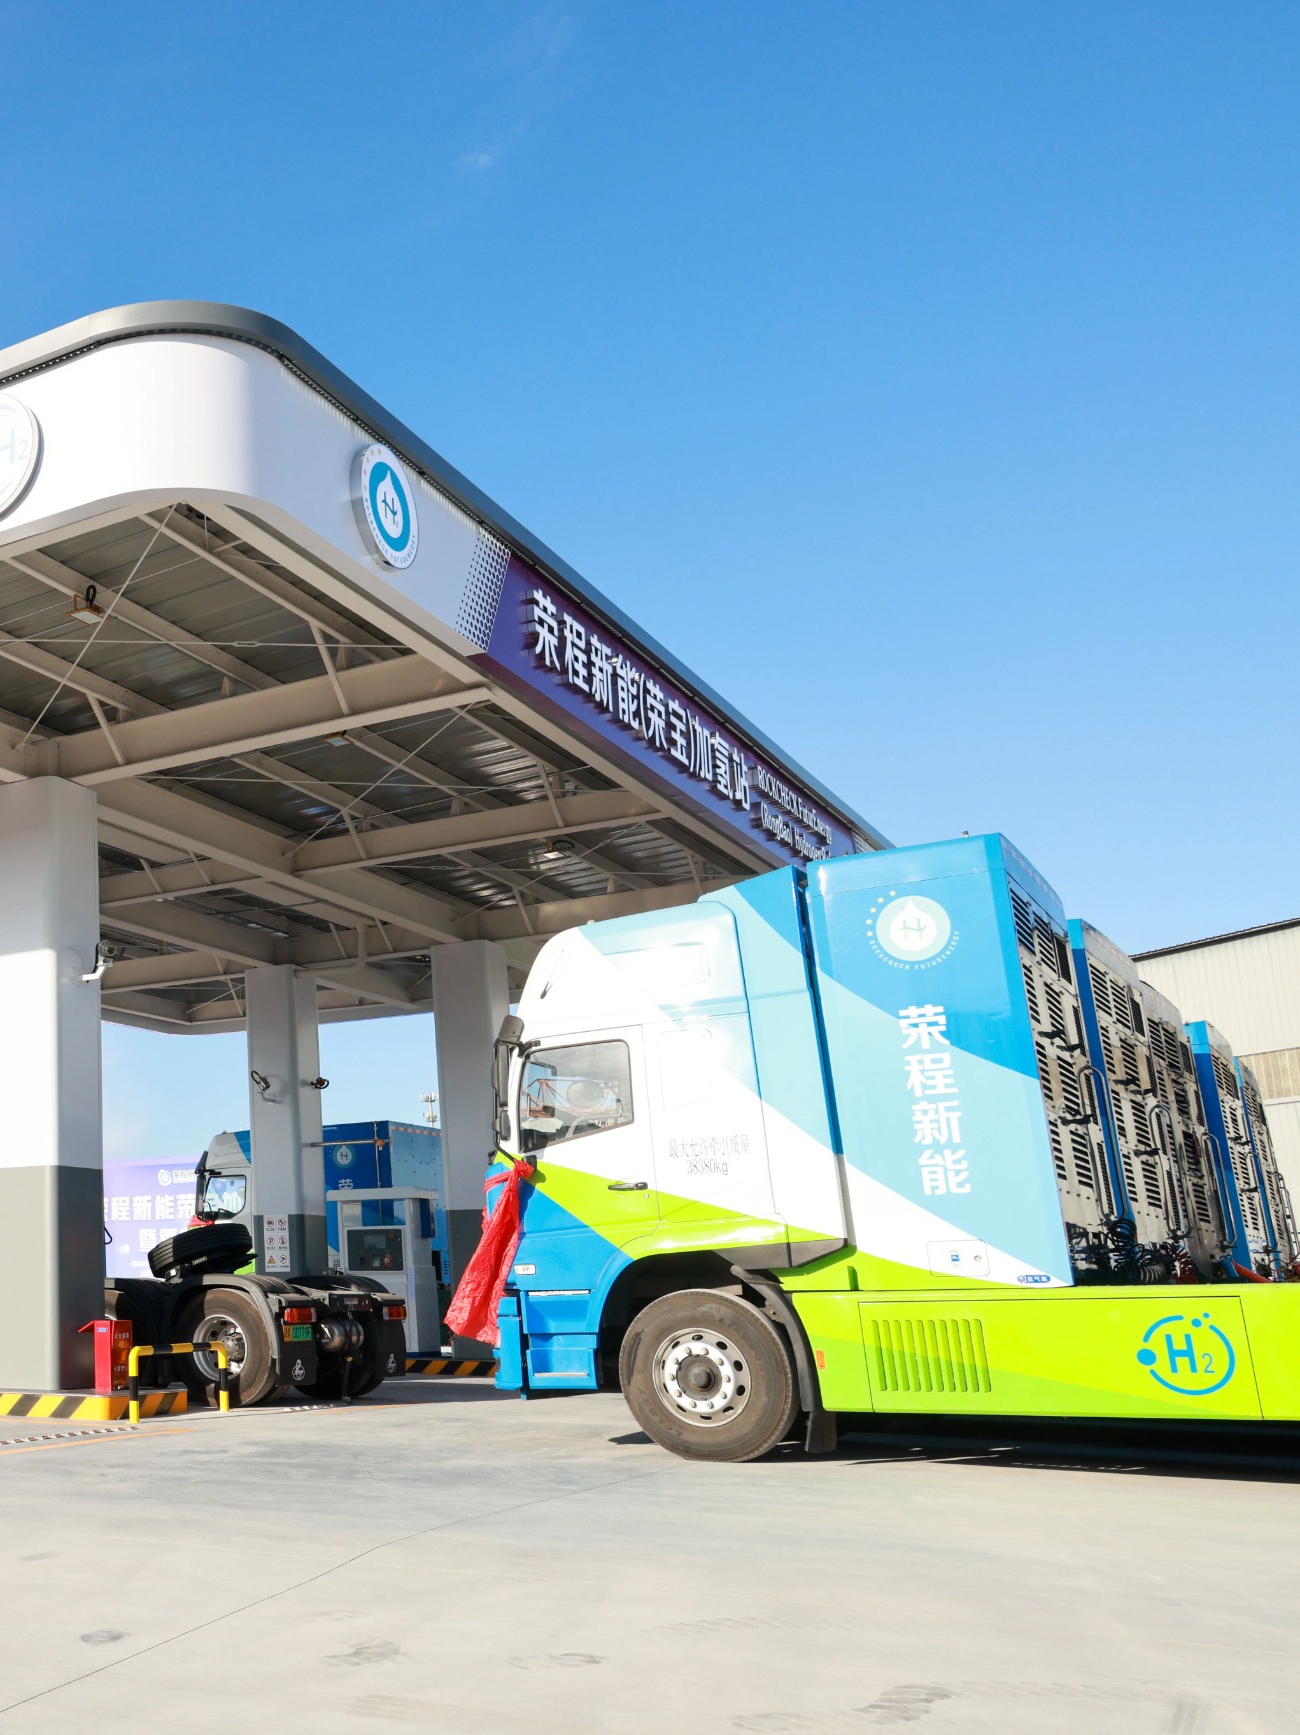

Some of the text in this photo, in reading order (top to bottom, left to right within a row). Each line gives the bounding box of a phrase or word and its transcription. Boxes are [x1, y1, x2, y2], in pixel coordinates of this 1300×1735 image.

[364, 497, 389, 556] ROCKCHECK
[533, 588, 750, 811] 荣程新能(荣宝)加氢站
[757, 765, 799, 818] ROCKCHECK
[869, 930, 961, 970] ROCKCHECK FUTURENERGY
[899, 1004, 971, 1196] 荣程新能
[668, 1134, 751, 1158] 最大允许牵引质量
[687, 1158, 728, 1175] 38380kg
[1165, 1333, 1216, 1374] H2
